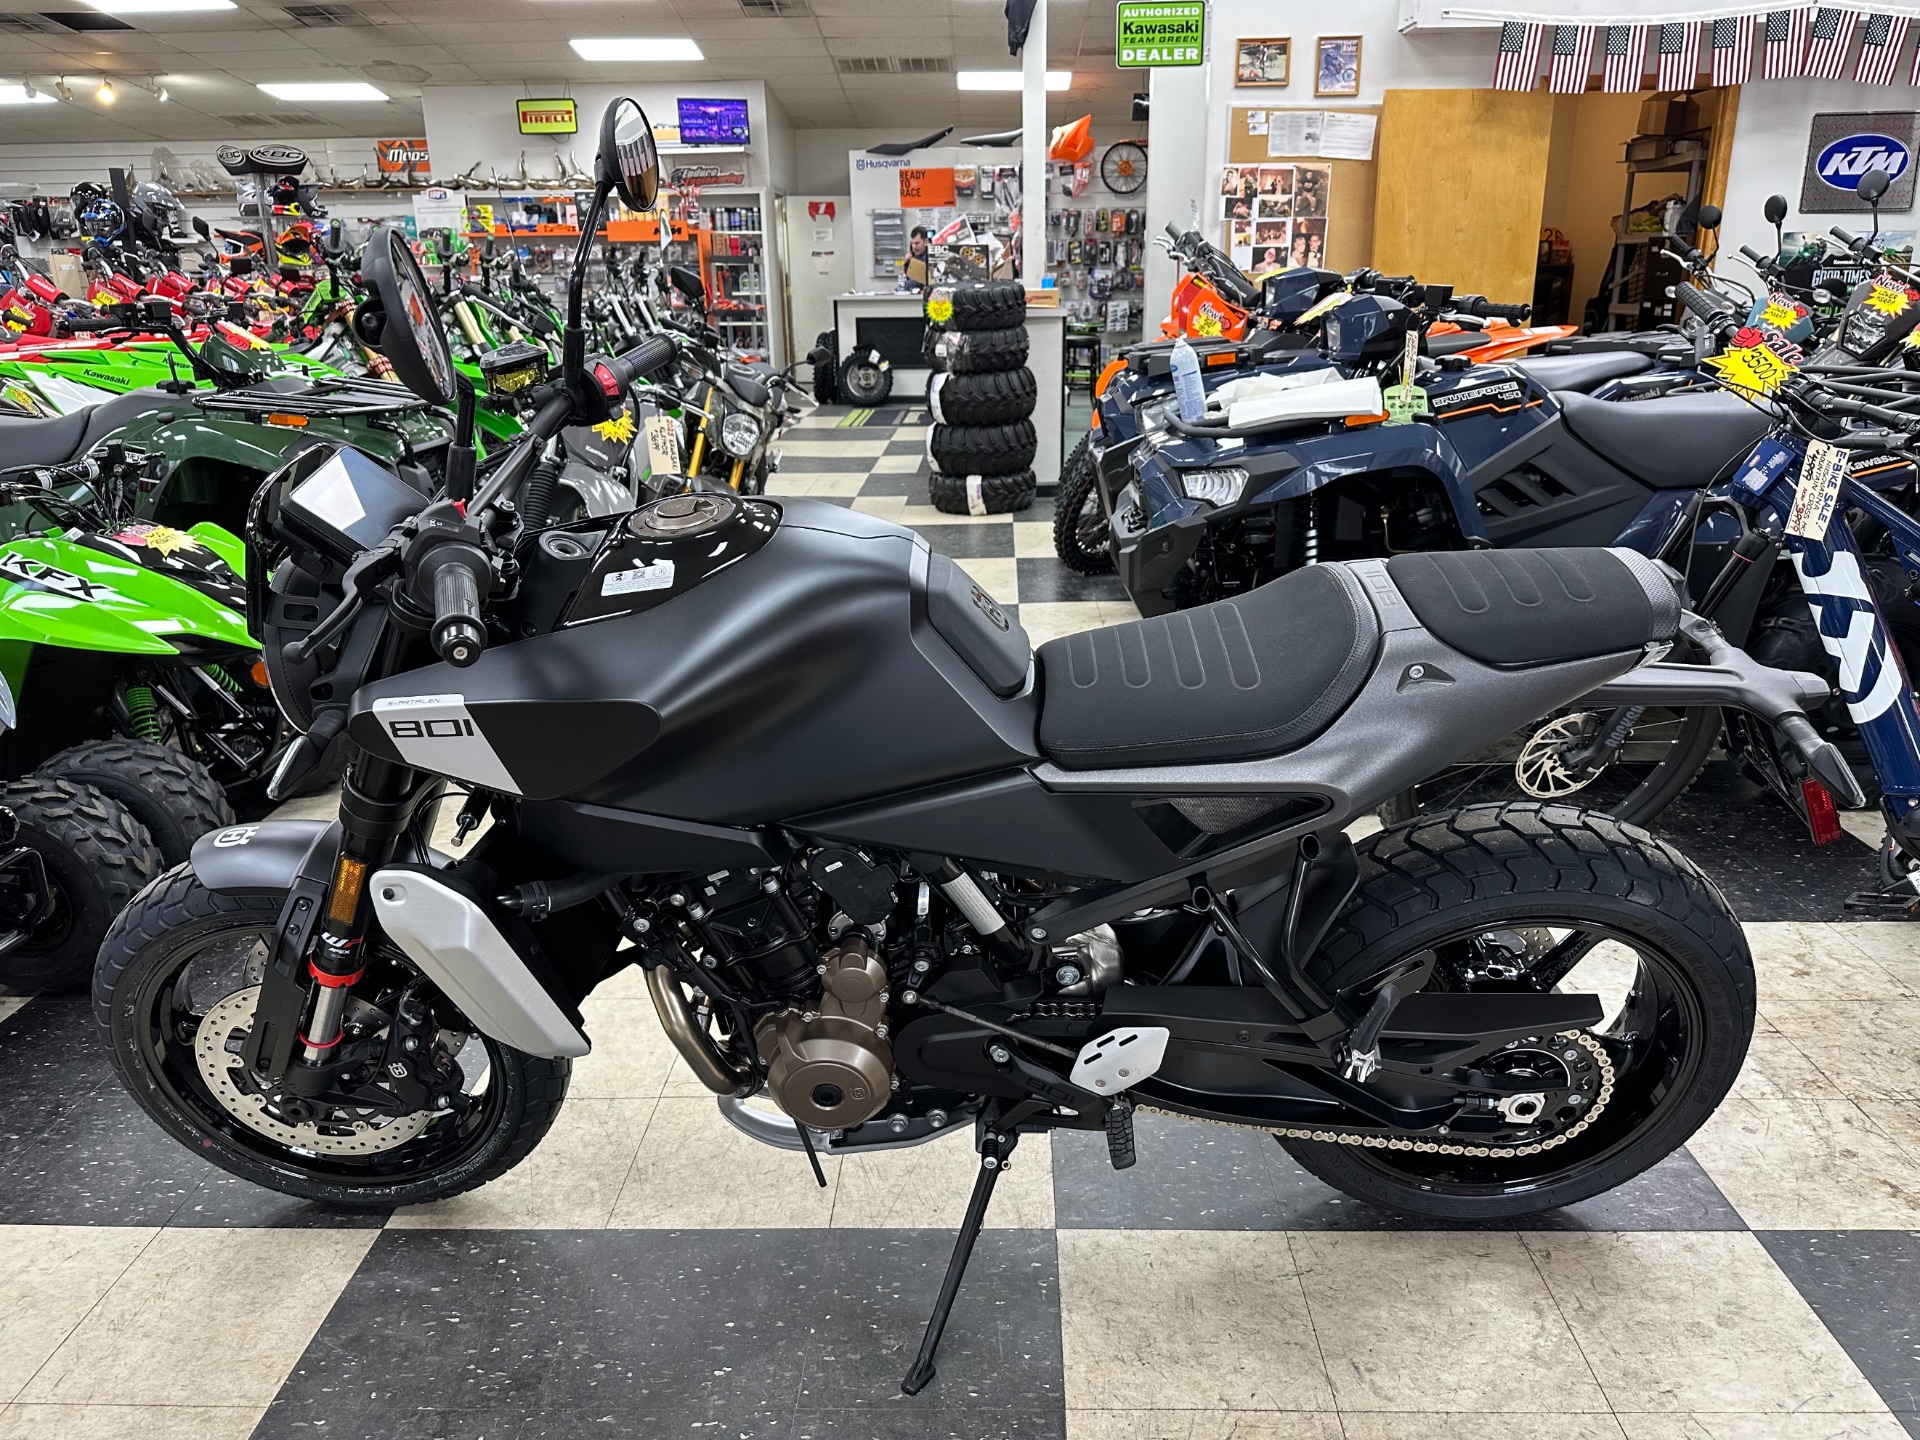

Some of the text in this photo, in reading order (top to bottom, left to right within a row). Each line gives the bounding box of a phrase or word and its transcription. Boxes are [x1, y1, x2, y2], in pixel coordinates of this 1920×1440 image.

[1123, 7, 1200, 17] AUTHORIZED
[1123, 20, 1199, 35] Kawasaki
[1123, 35, 1199, 44] TEAM GREEN
[1122, 48, 1199, 62] DEALER
[521, 110, 573, 124] PIRELLI
[219, 150, 241, 159] KBC
[255, 149, 303, 158] KBC
[866, 159, 911, 169] Husqvarna
[1821, 146, 1906, 175] KTM
[682, 166, 718, 178] Enduro
[900, 170, 926, 180] READY
[901, 180, 911, 189] TO
[900, 188, 922, 198] RACE
[967, 215, 988, 223] COTT
[653, 226, 682, 235] KM
[928, 246, 949, 254] EBC
[1875, 276, 1908, 294] New!
[1878, 290, 1898, 300] LOWER
[1769, 294, 1798, 310] New!
[1200, 302, 1222, 321] New!
[83, 368, 131, 386] Kawasaki
[1498, 390, 1522, 400] 450
[585, 445, 609, 461] Kawasaki
[1811, 449, 1828, 490] MOUNTAIN
[1827, 449, 1848, 489] E-BIKE
[1804, 492, 1816, 519] CROSS
[0, 553, 108, 599] KFX
[387, 698, 441, 707] SVARTPILEN
[388, 719, 475, 738] 801
[328, 947, 351, 955] APEX
[1645, 924, 1721, 998] PIRELLI
[1026, 1077, 1076, 1104] 801
